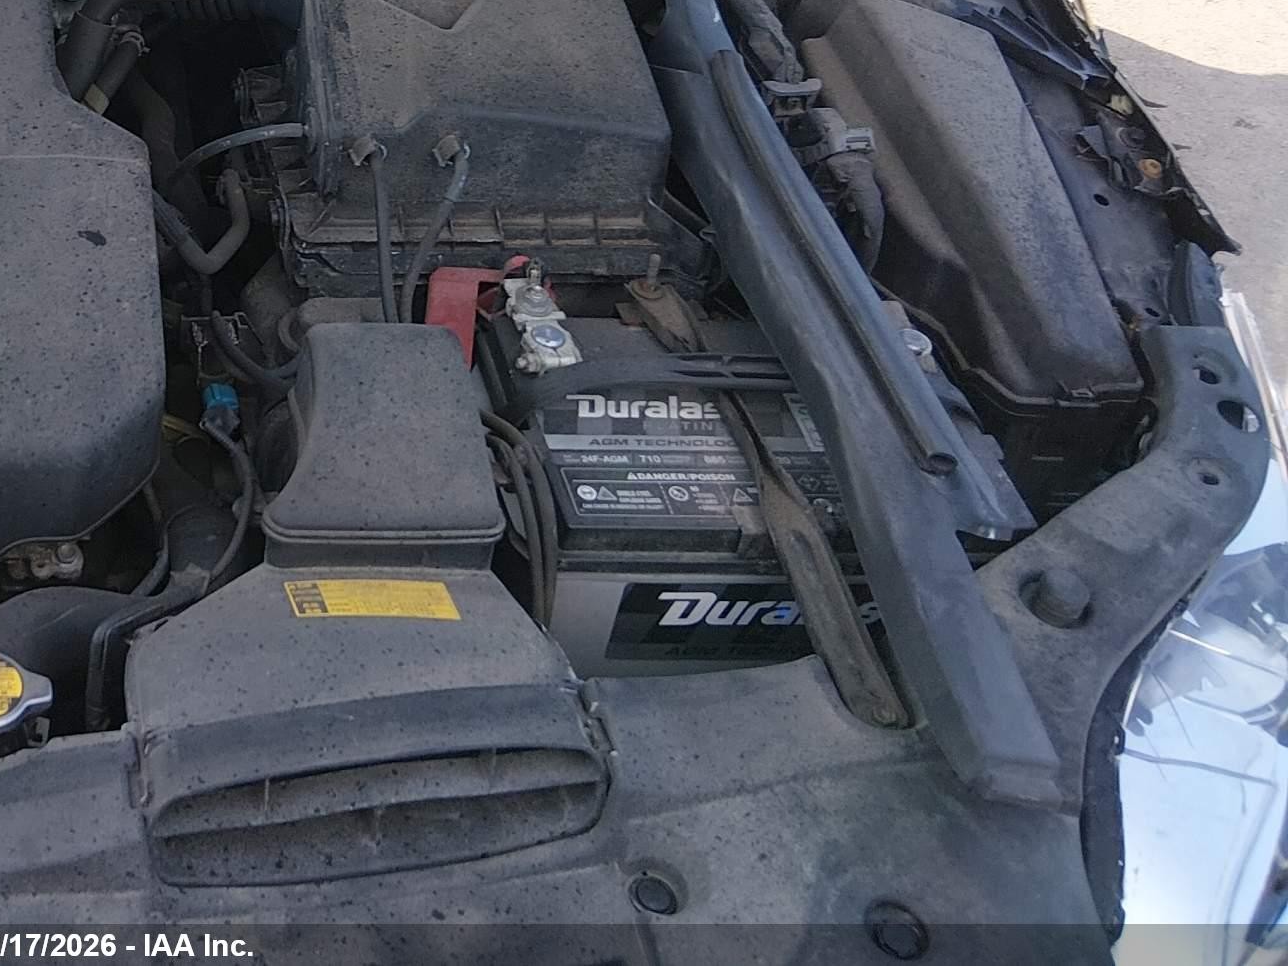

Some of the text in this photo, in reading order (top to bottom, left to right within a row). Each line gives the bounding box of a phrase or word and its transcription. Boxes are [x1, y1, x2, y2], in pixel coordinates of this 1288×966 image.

[566, 394, 721, 419] Duralas
[589, 438, 738, 448] AGM TECHNOLOG
